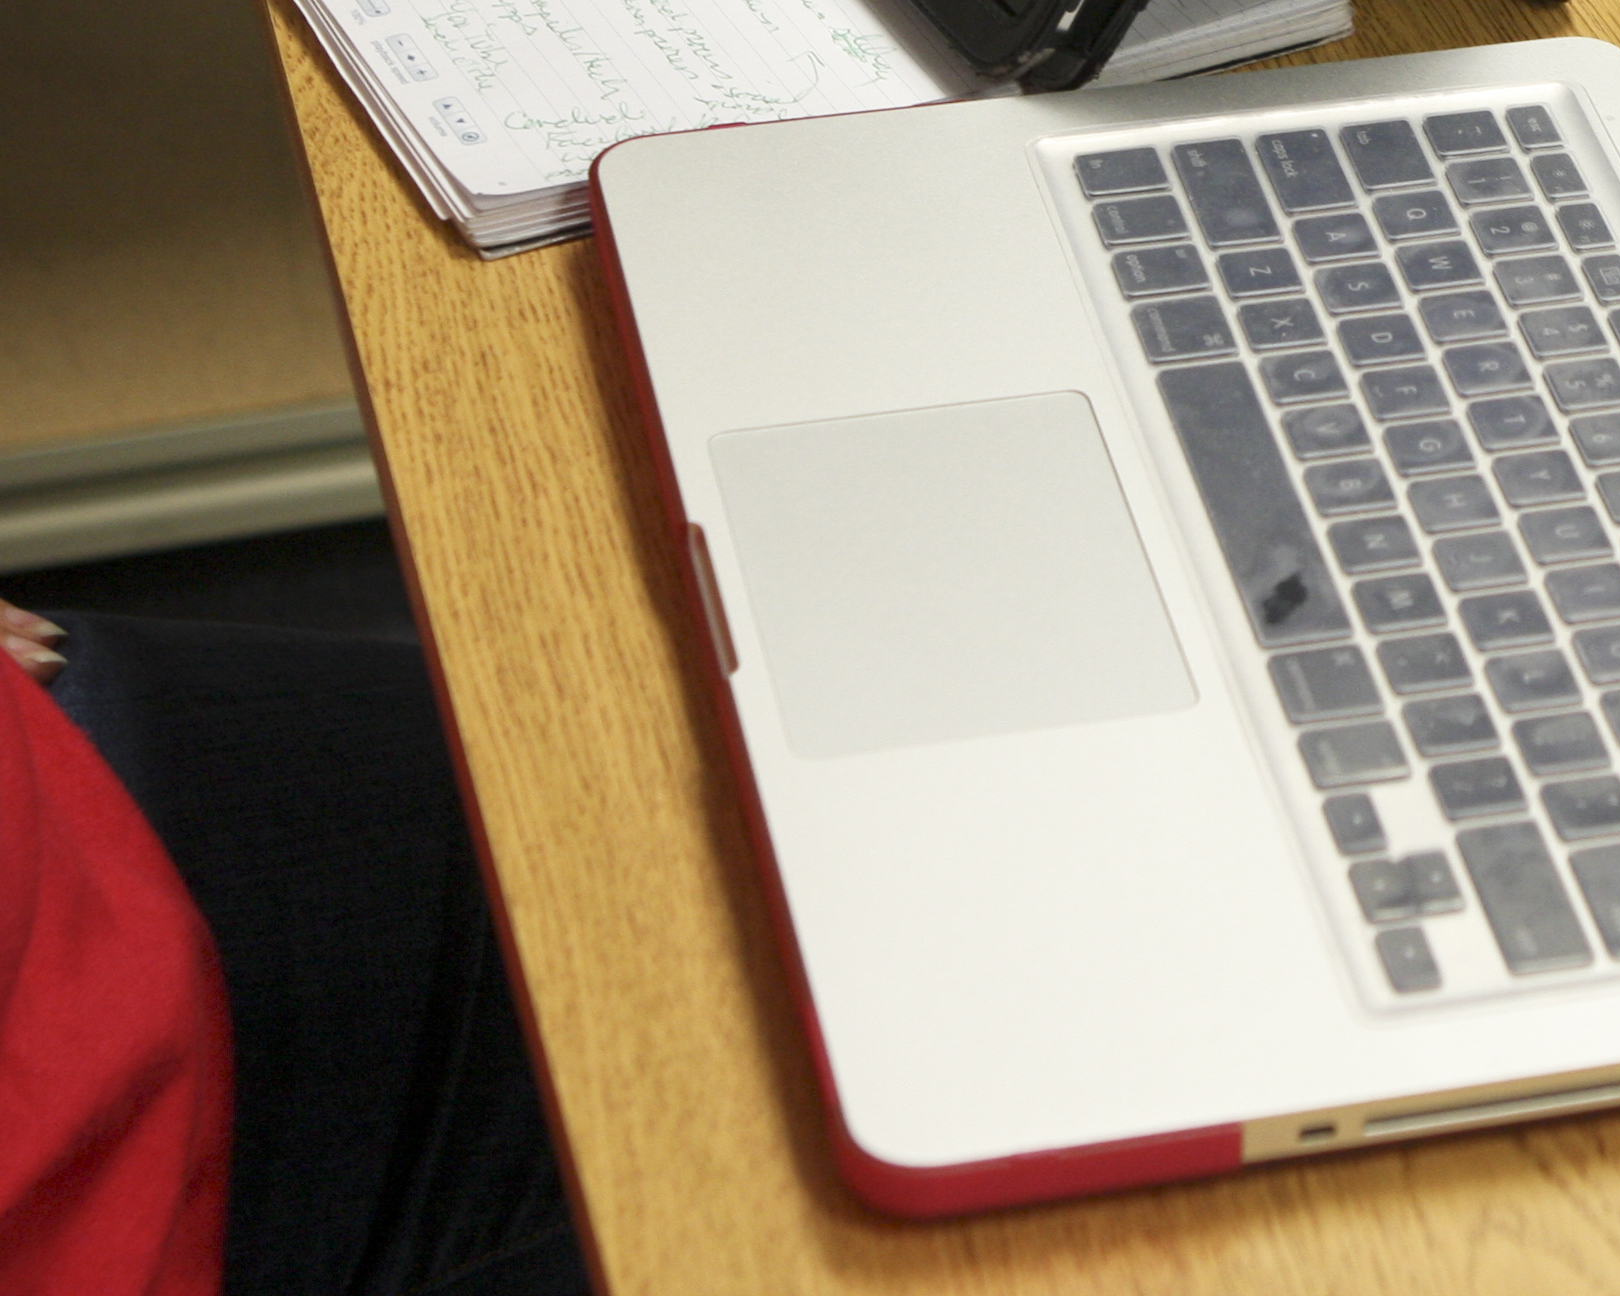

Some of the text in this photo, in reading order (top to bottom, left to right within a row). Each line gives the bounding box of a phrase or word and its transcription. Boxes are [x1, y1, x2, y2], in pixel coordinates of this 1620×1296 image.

[1271, 139, 1297, 179] caps lock
[1406, 209, 1427, 220] Q
[1324, 231, 1346, 243] A
[1126, 254, 1147, 284] option
[1428, 256, 1452, 271] W
[1249, 265, 1272, 278] Z
[1348, 280, 1369, 292] S
[1453, 309, 1475, 319] E
[1270, 317, 1293, 330] X
[1370, 332, 1393, 344] D
[1477, 360, 1499, 372] R
[1294, 369, 1316, 381] C
[1396, 385, 1417, 396] F
[1504, 414, 1526, 426] T
[1419, 438, 1441, 452] G
